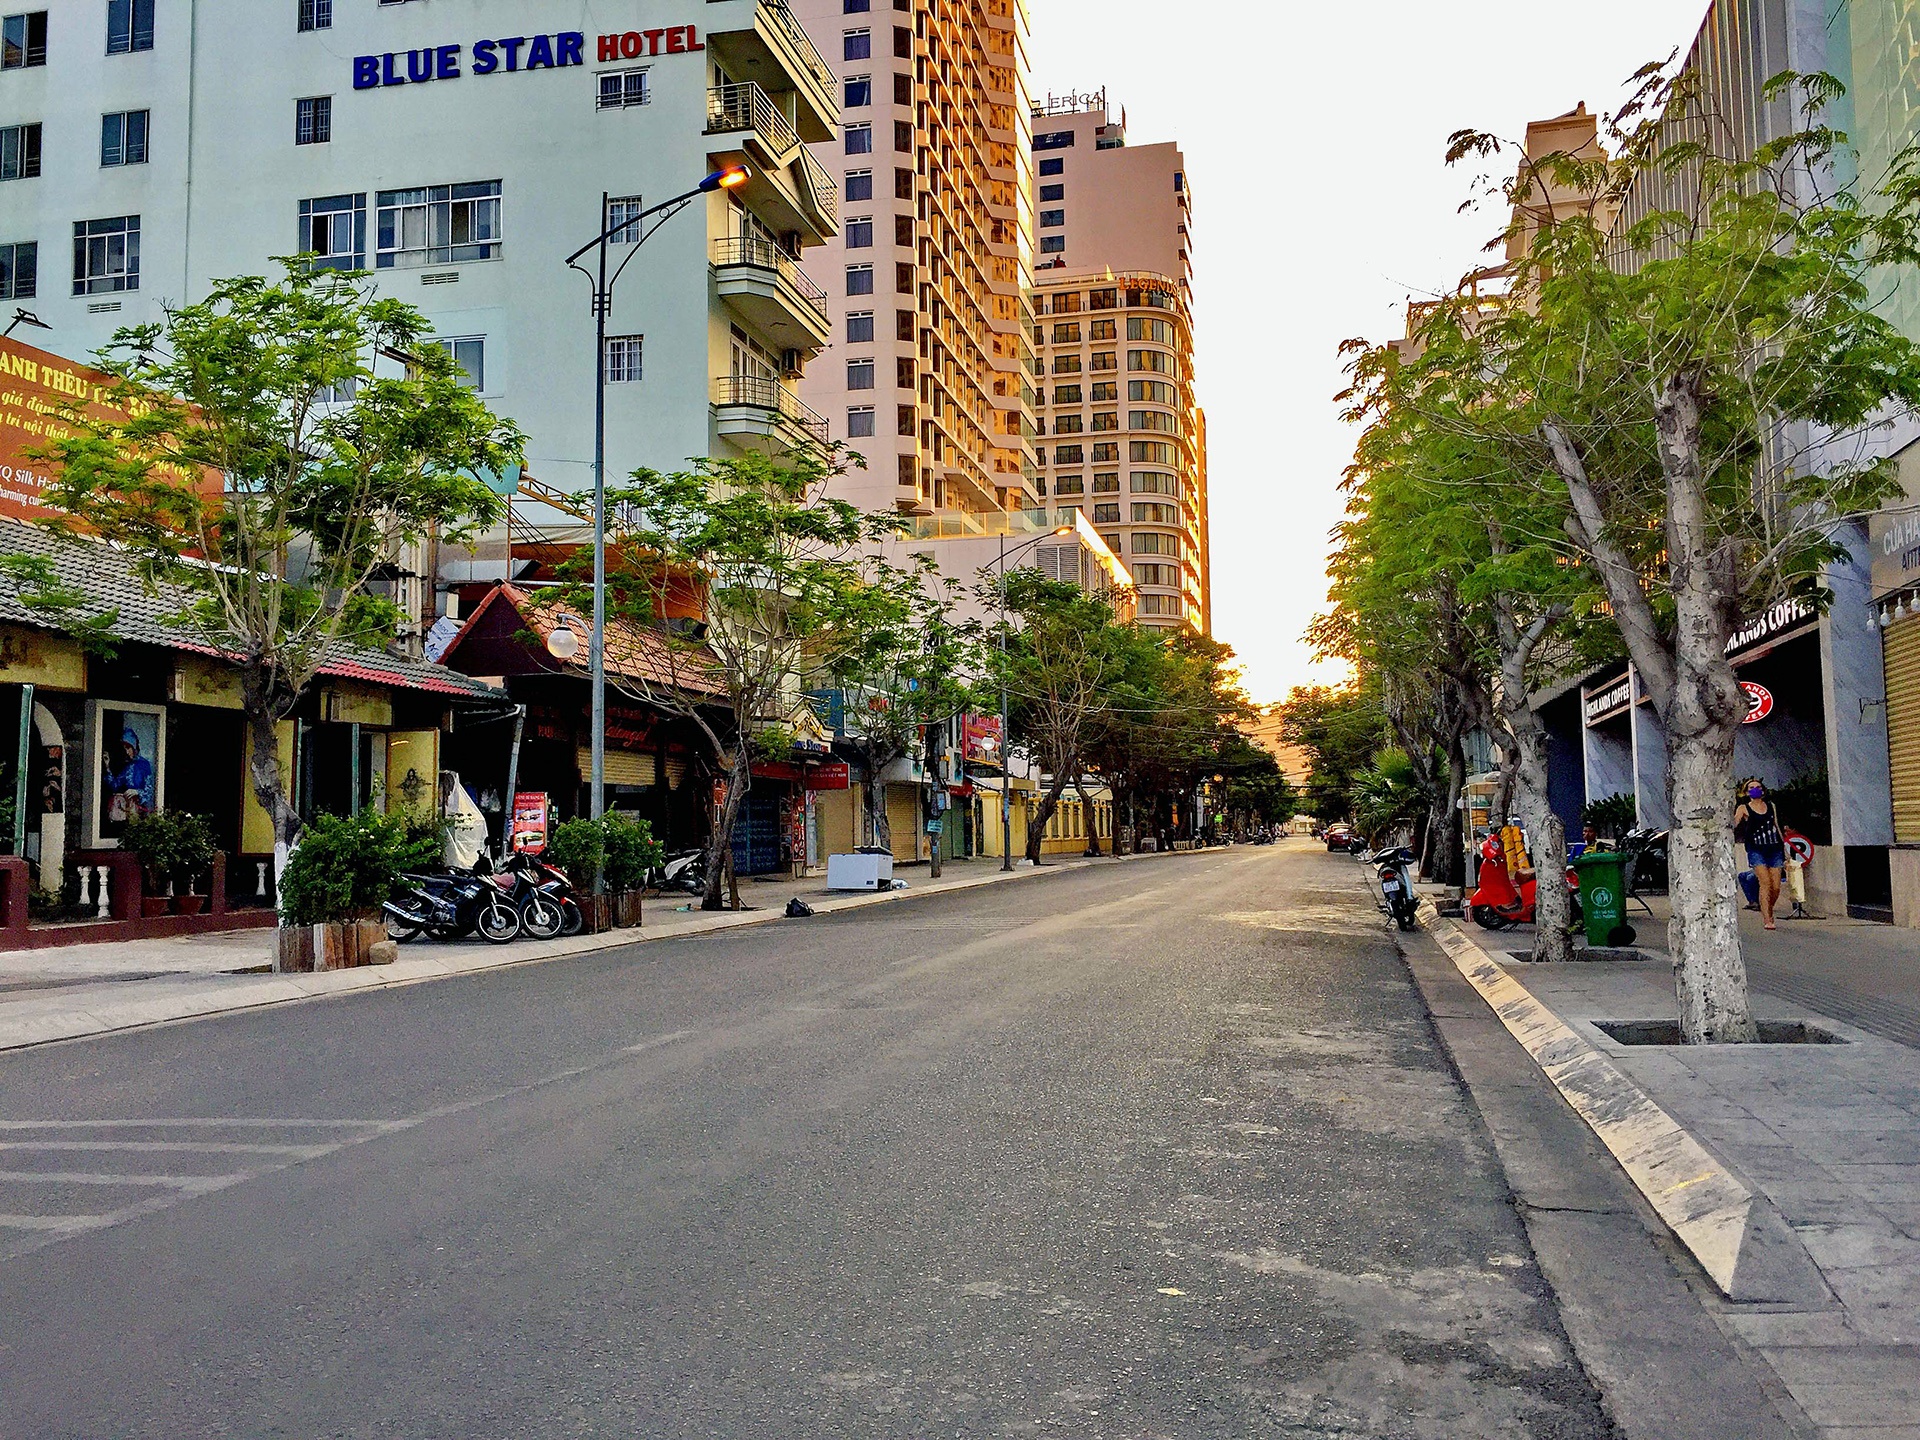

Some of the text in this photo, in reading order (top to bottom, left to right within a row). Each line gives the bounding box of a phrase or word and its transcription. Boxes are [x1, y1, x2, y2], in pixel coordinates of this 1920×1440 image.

[353, 24, 706, 90] BLUE STAR HOTEL
[1, 389, 24, 406] giá
[26, 395, 56, 417] đậm
[6, 412, 22, 428] trí
[23, 419, 44, 436] nội
[14, 469, 34, 487] Silk
[1611, 682, 1630, 707] COFFEE
